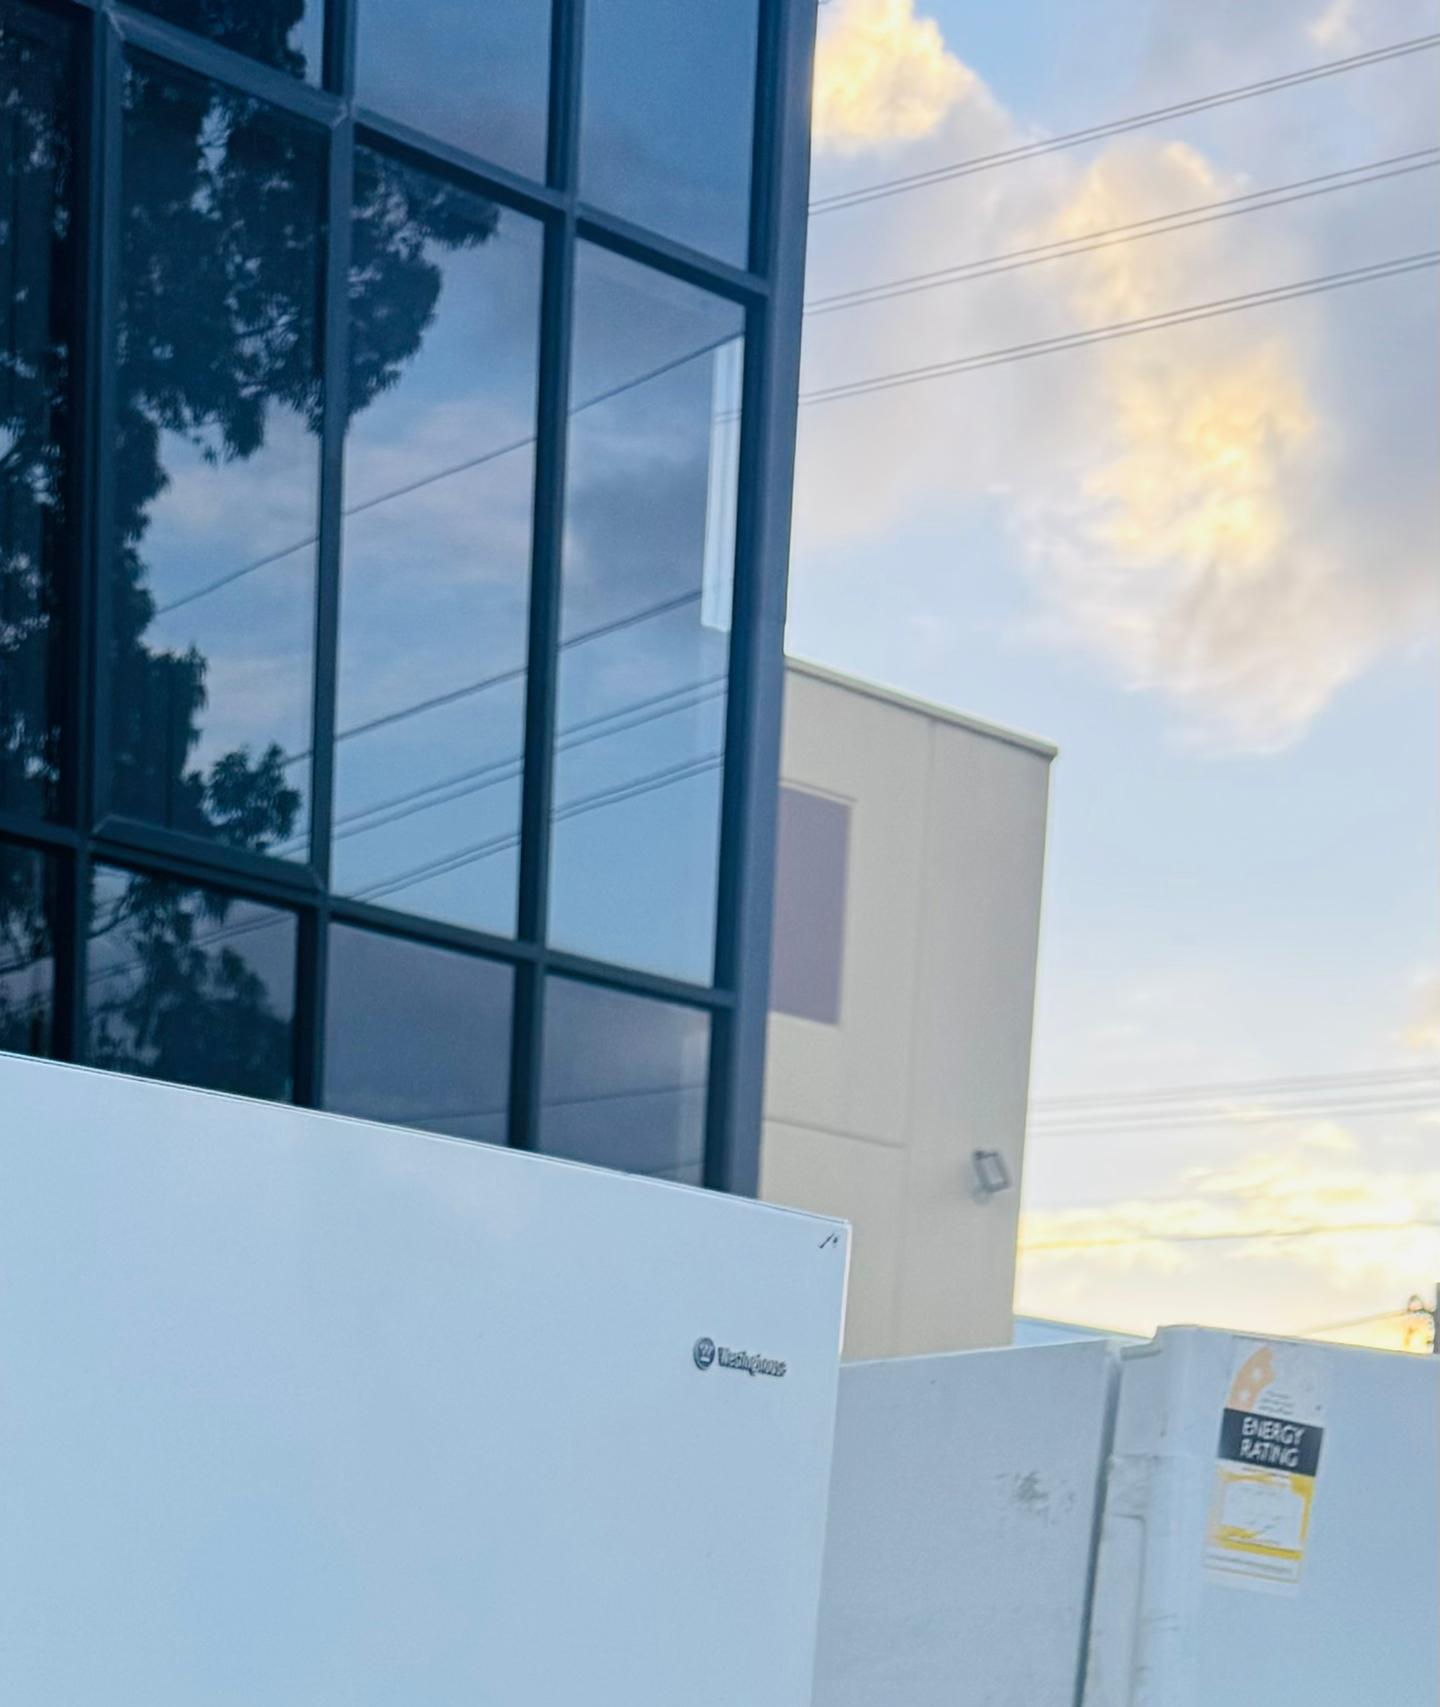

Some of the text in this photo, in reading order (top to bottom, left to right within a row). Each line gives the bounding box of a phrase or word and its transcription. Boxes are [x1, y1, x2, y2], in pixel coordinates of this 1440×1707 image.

[718, 1347, 787, 1377] Westinghouse
[1242, 1416, 1304, 1445] ENERGY
[1240, 1438, 1299, 1467] RATING
